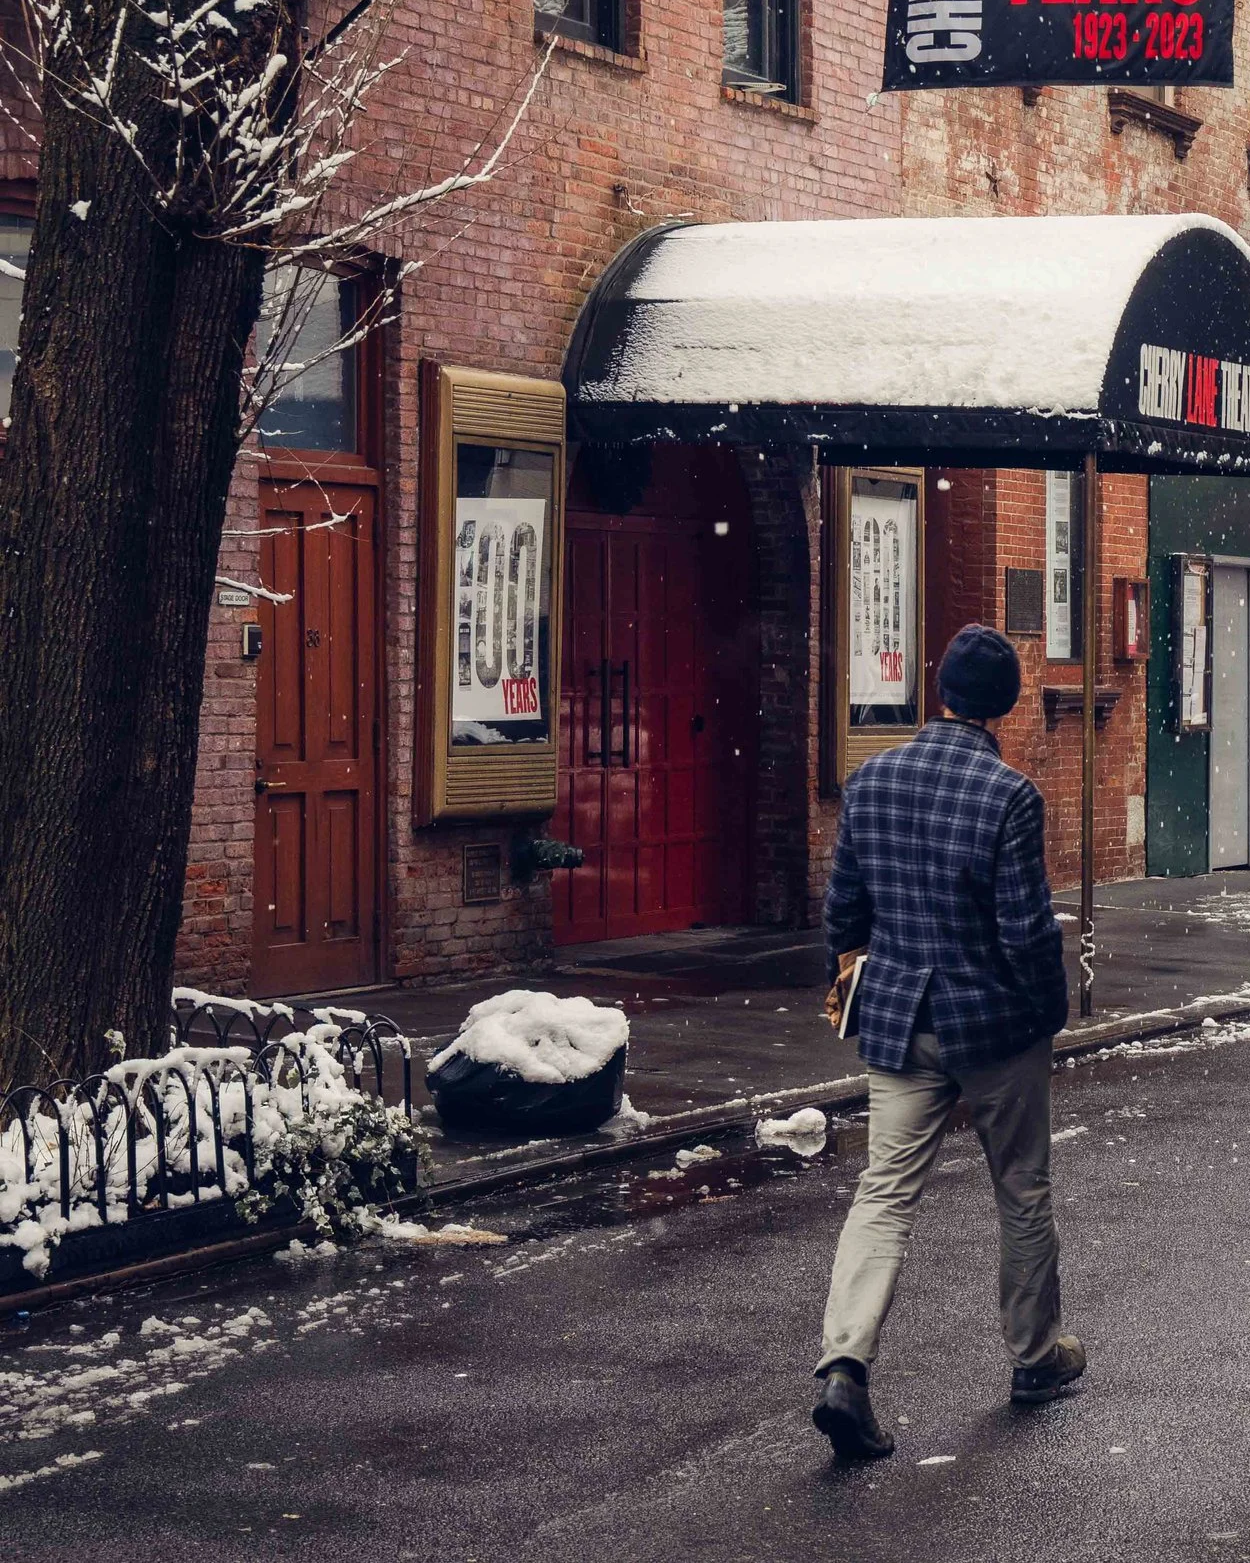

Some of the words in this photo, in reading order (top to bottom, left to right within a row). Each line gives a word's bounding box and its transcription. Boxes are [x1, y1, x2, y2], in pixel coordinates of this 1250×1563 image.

[1073, 12, 1127, 60] 1923
[1145, 12, 1204, 60] 2023
[1138, 343, 1186, 421] CHERRY
[1186, 353, 1219, 427] LANE
[457, 520, 537, 689] 100
[880, 651, 903, 682] YEARS
[501, 677, 538, 715] YEARS
